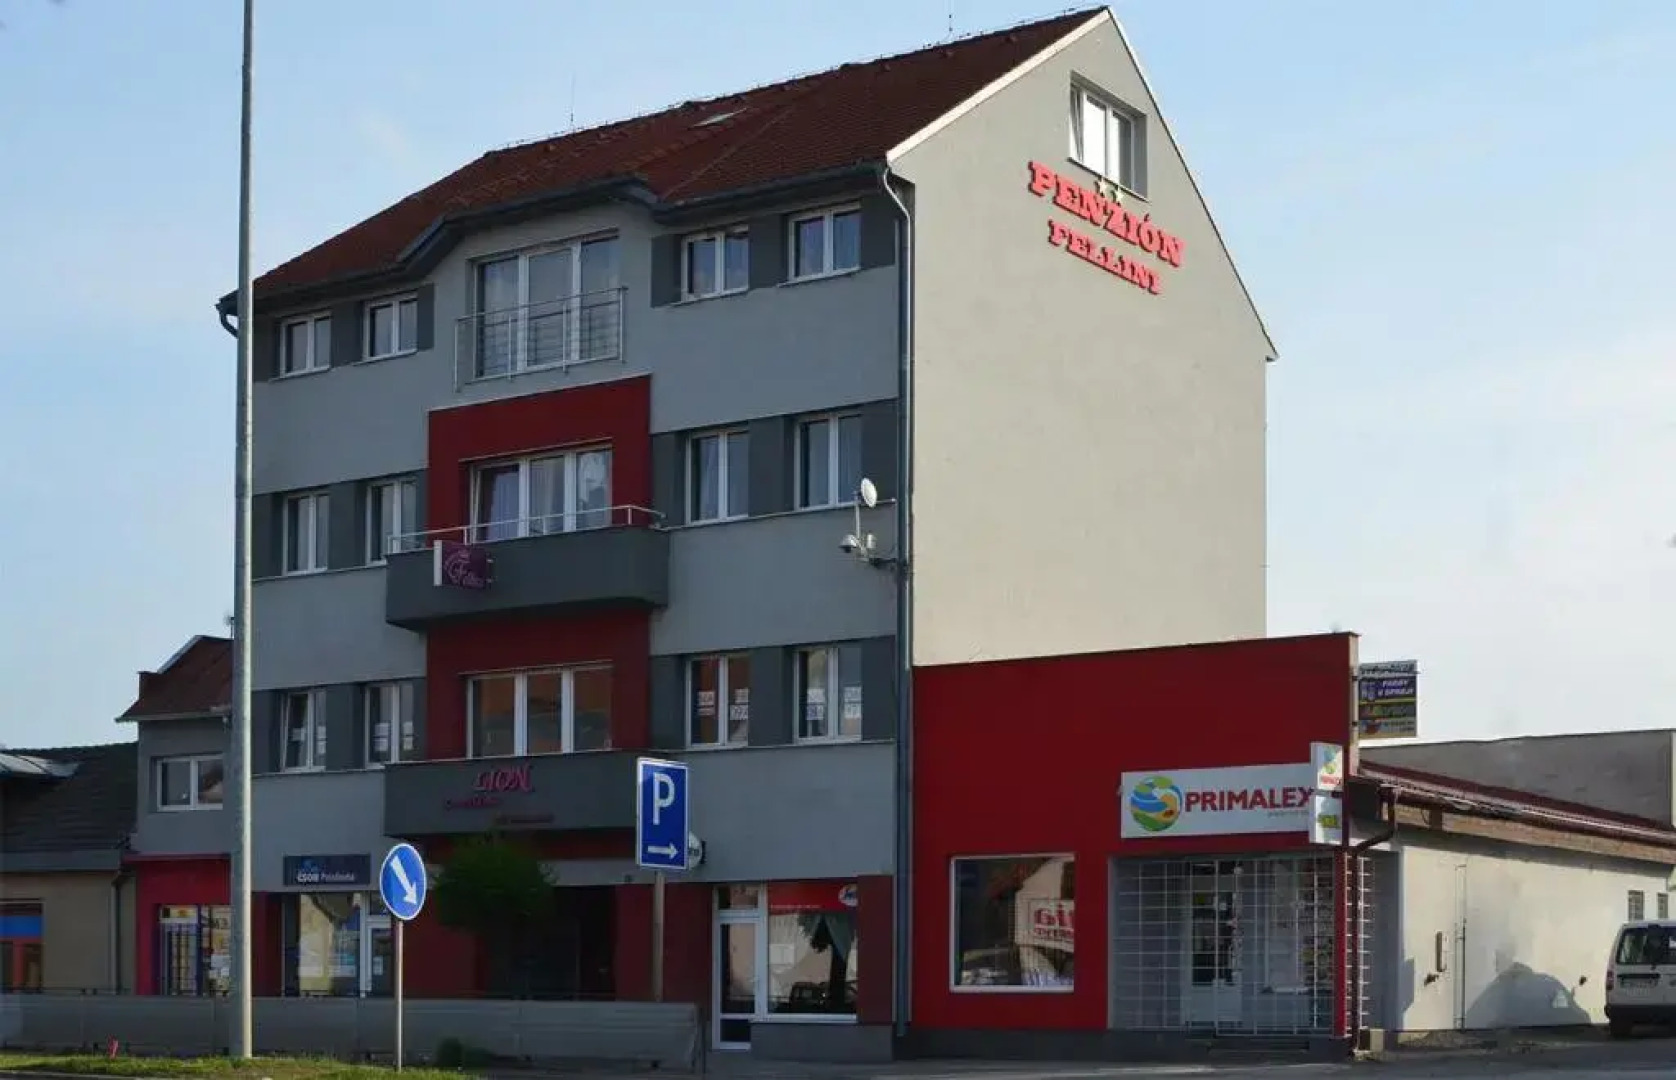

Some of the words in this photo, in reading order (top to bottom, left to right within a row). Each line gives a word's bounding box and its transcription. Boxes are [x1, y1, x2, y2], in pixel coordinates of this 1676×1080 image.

[1028, 160, 1185, 267] PENZIÓN
[1048, 218, 1161, 295] FELLINI
[653, 772, 675, 825] P
[1185, 786, 1314, 812] PRIMALEX
